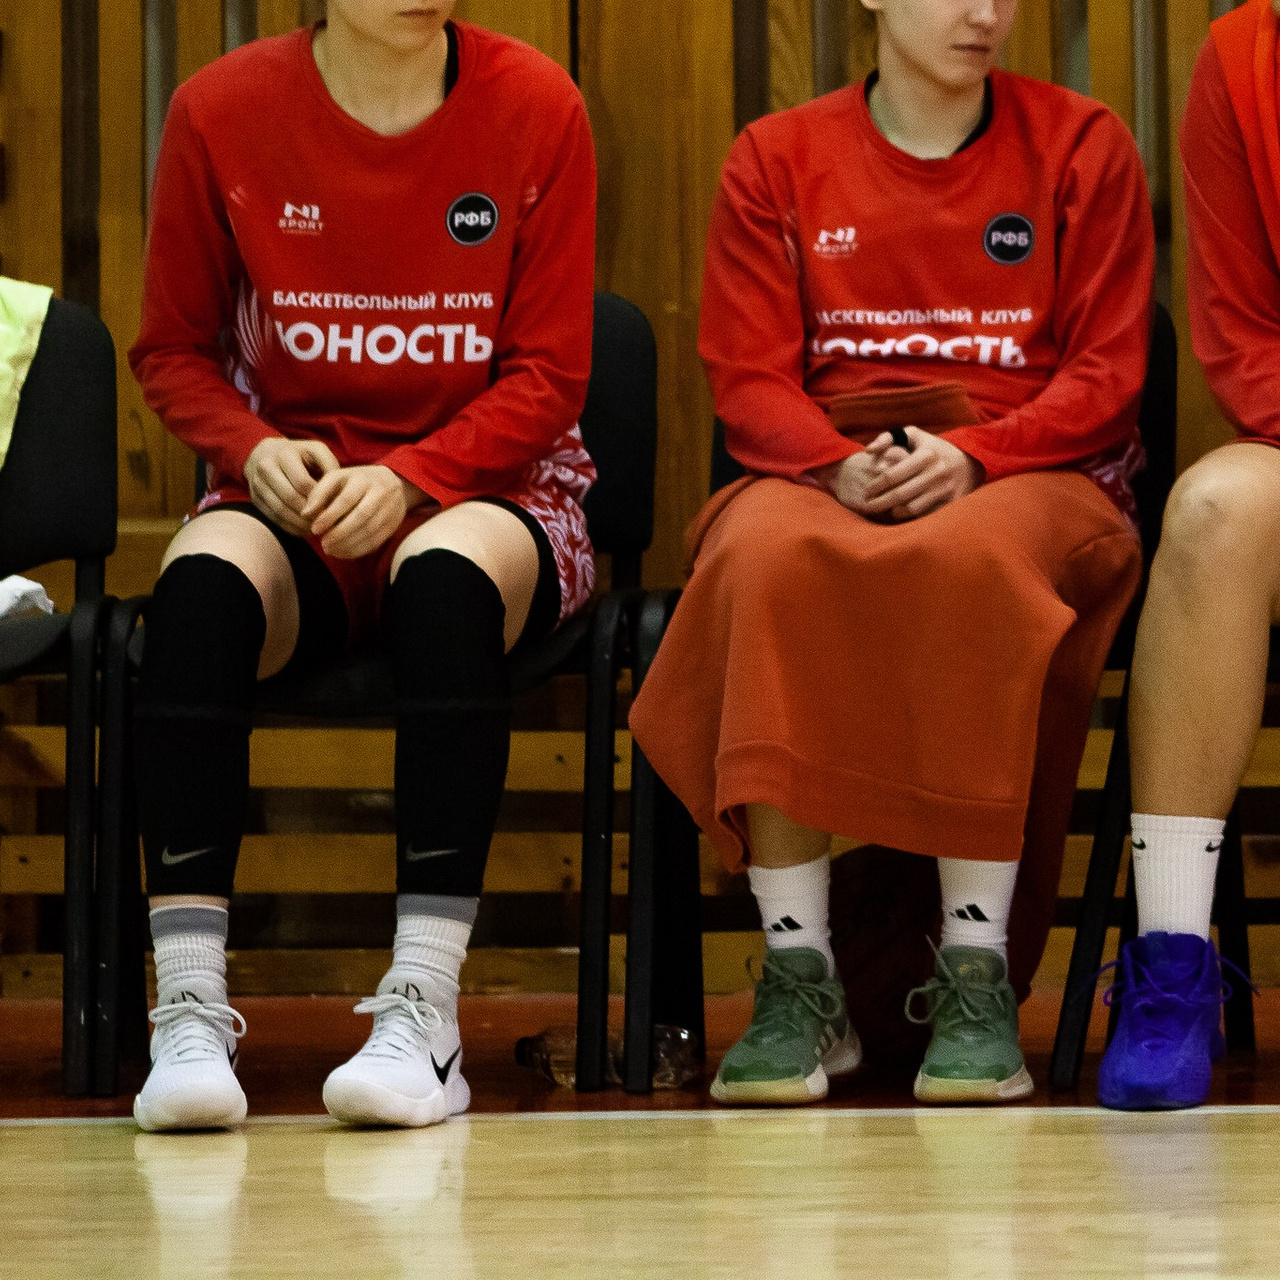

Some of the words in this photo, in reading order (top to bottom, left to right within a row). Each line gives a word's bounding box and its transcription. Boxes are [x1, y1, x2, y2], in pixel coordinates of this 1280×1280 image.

[454, 210, 491, 228] РФБ
[991, 231, 1029, 247] РФБ
[272, 290, 436, 311] БАСКЕТБОЛЬНЫЙ
[443, 291, 494, 310] КЛУБ
[980, 307, 1033, 325] КЛУБ
[274, 321, 494, 364] ЮНОСТЬ
